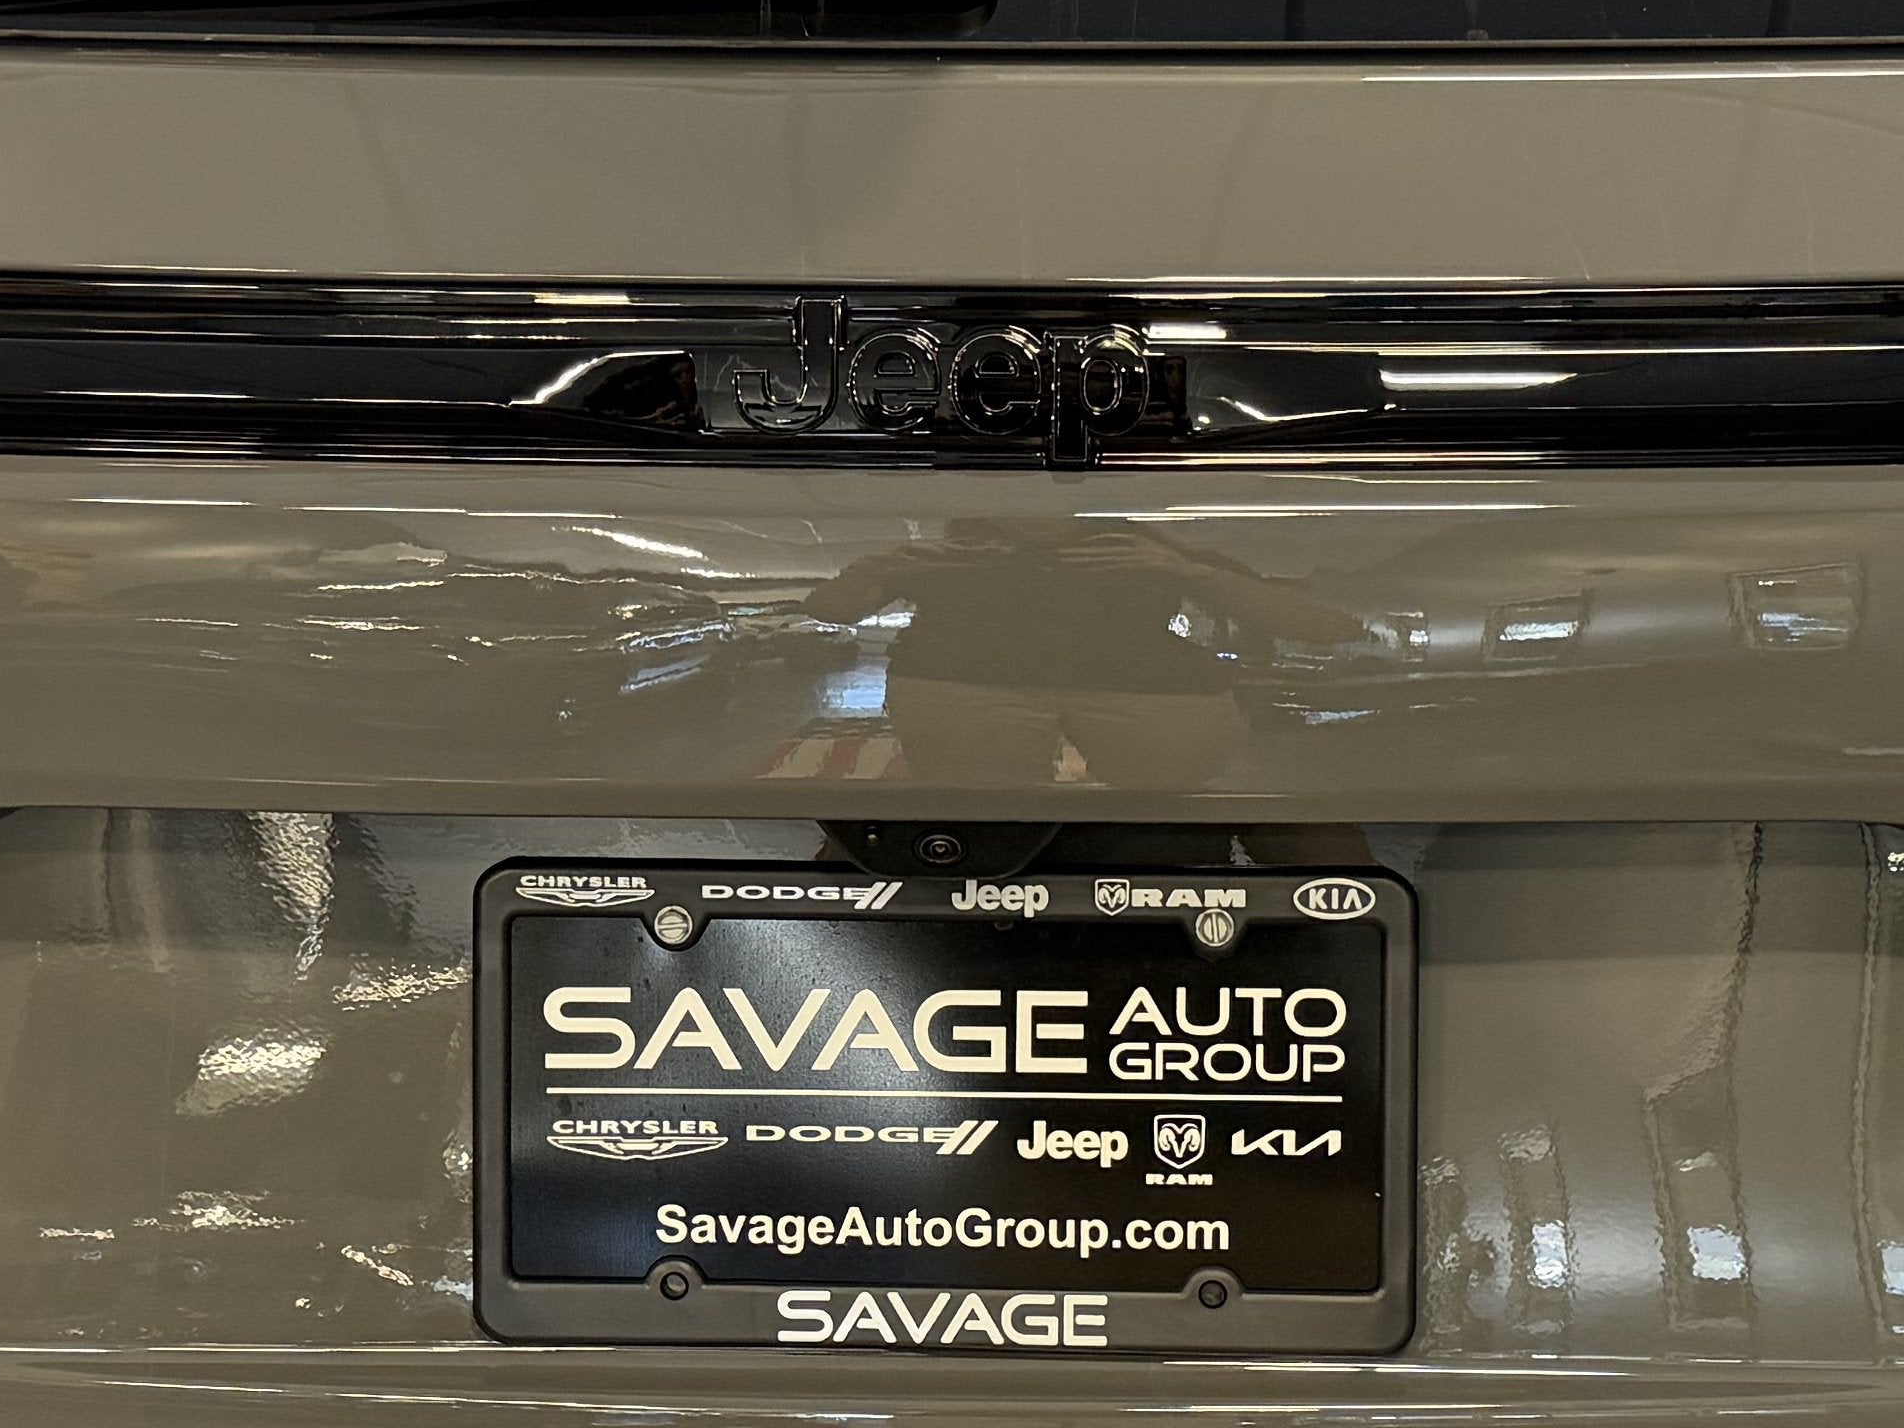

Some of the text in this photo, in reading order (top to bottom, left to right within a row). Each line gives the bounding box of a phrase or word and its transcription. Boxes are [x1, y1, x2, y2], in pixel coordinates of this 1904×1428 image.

[732, 294, 1151, 470] Jeep
[520, 874, 647, 889] CHRYSLER
[701, 884, 866, 903] DODGE
[951, 879, 1050, 918] Jeep
[1131, 888, 1247, 909] RAM
[543, 986, 1089, 1074] SAVAGE
[1109, 986, 1347, 1038] AUTO
[1108, 1042, 1346, 1083] GROUP
[552, 1119, 719, 1138] CHRYSLER
[745, 1124, 956, 1145] DODGE
[1016, 1120, 1129, 1169] Jeep
[1230, 1128, 1342, 1157] KIA
[1145, 1173, 1214, 1186] RAM
[655, 1203, 1230, 1258] SavageAutoGroup.com
[776, 1290, 1108, 1348] SAVAGE
